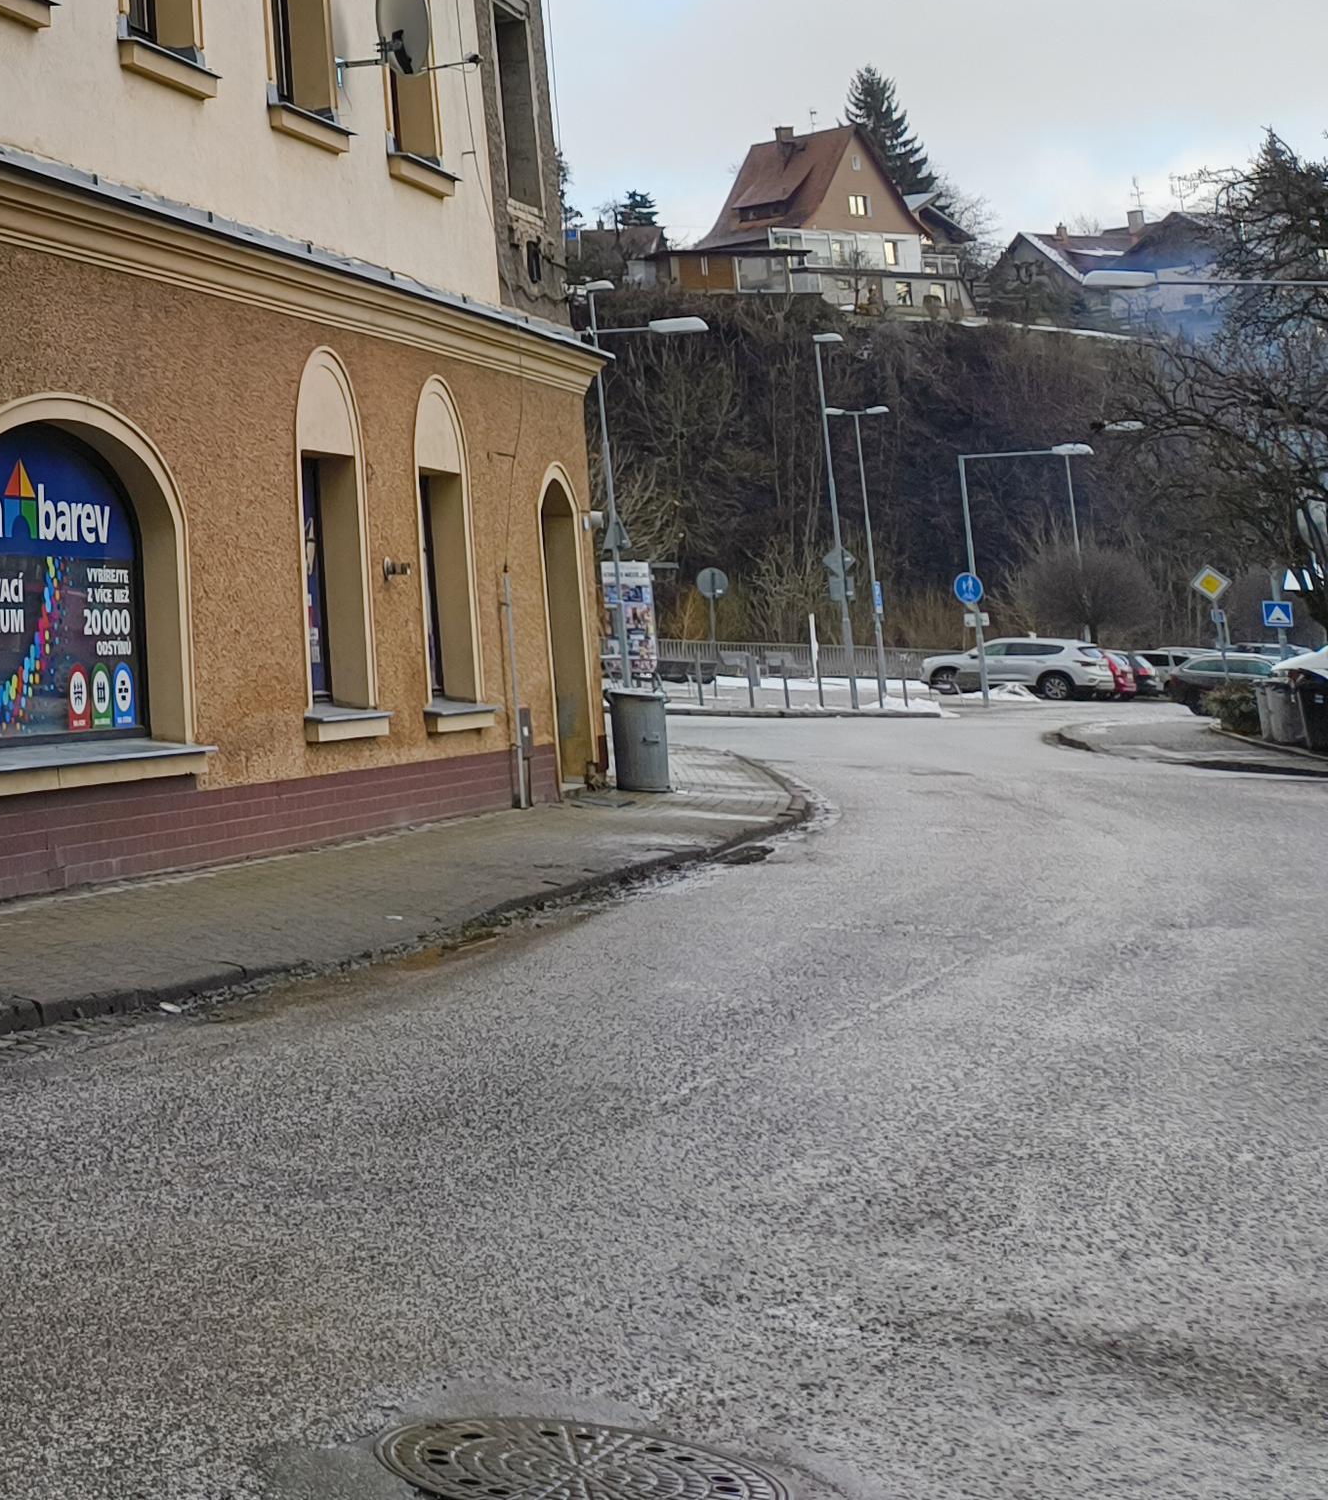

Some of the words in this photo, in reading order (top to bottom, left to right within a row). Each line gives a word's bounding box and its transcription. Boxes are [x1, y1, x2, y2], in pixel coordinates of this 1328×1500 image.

[38, 483, 110, 543] barev
[87, 587, 93, 603] Z
[94, 585, 112, 603] VÍCE
[114, 585, 129, 603] NEŽ
[96, 636, 131, 655] ODSTÍNŮ
